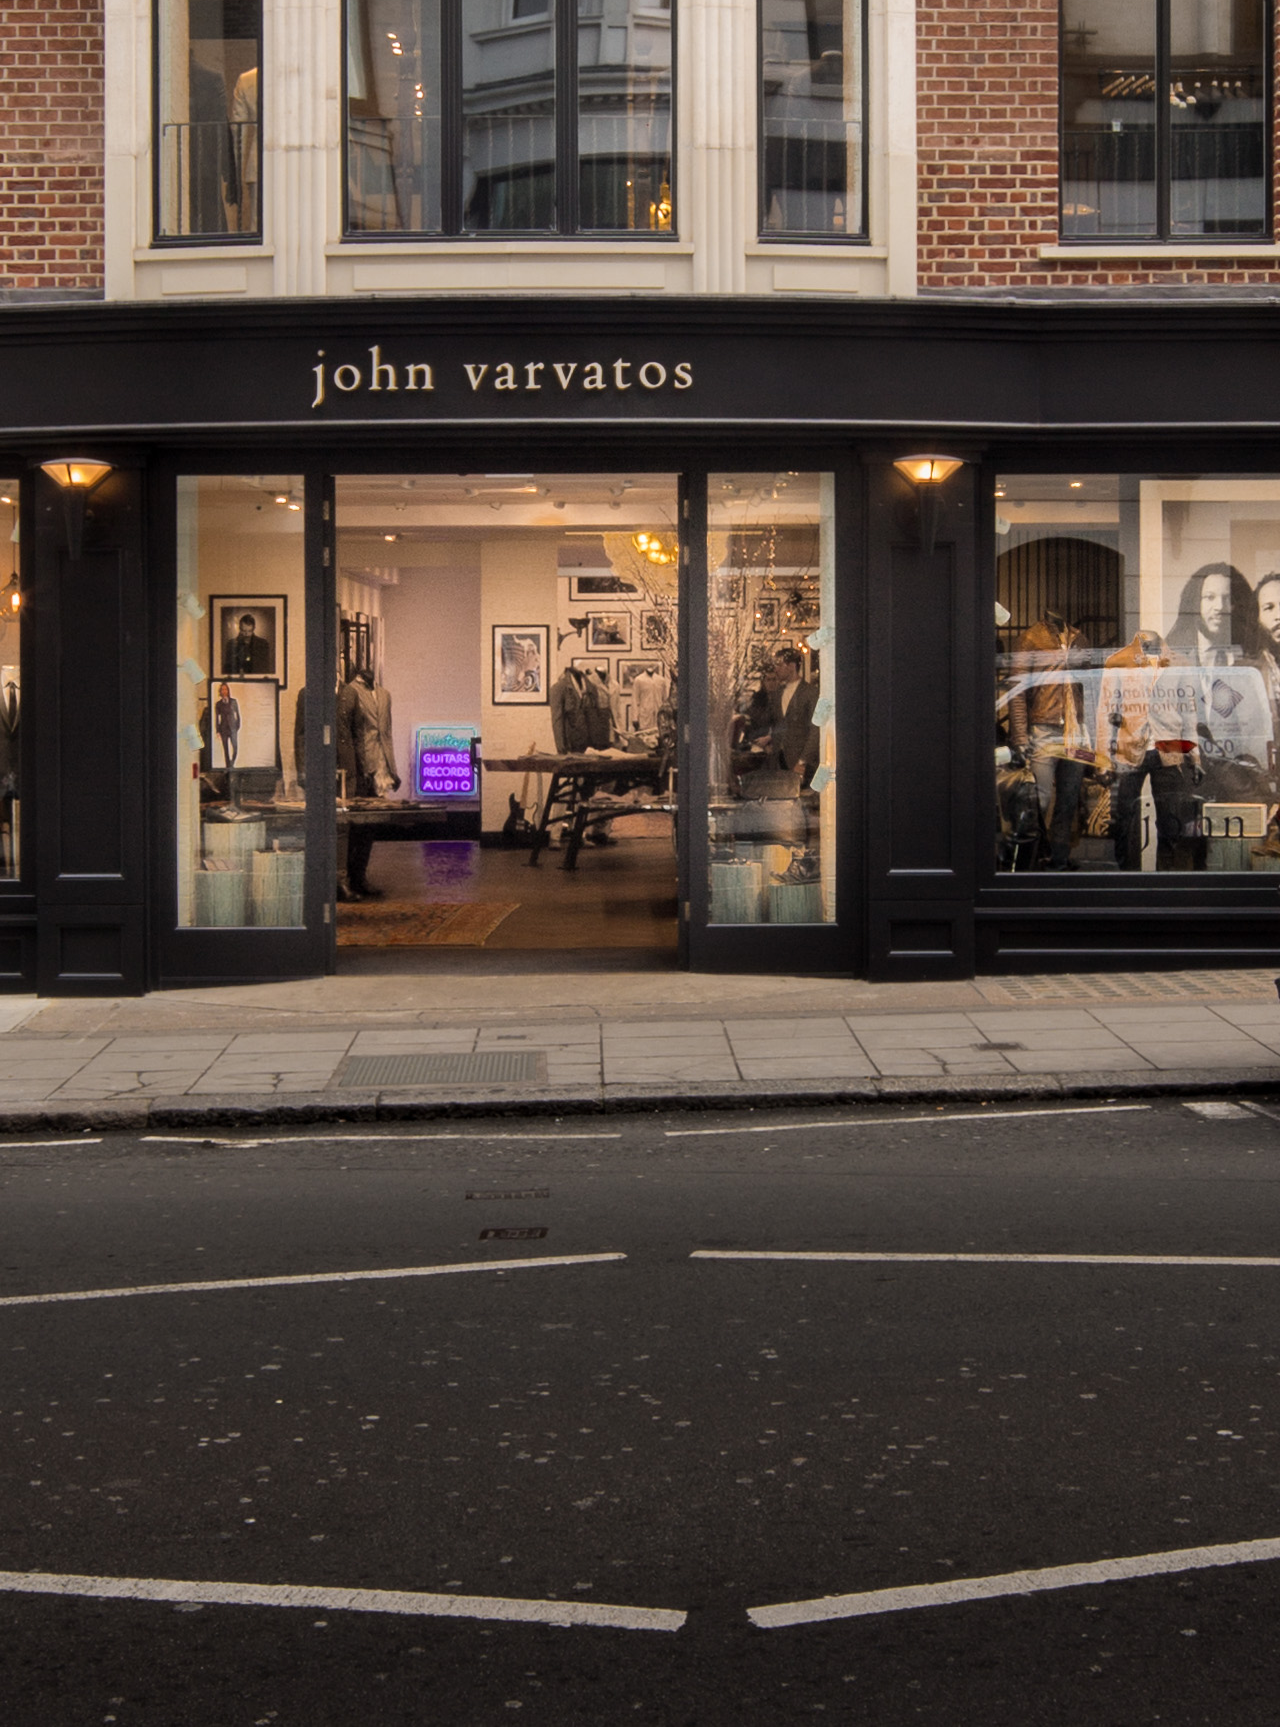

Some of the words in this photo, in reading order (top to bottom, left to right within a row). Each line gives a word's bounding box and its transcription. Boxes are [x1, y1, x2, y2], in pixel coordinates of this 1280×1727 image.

[311, 345, 435, 409] john
[463, 357, 694, 391] varvatos
[423, 753, 470, 764] GUITARS
[423, 767, 471, 777] RECORDS
[422, 780, 471, 791] AUDIO
